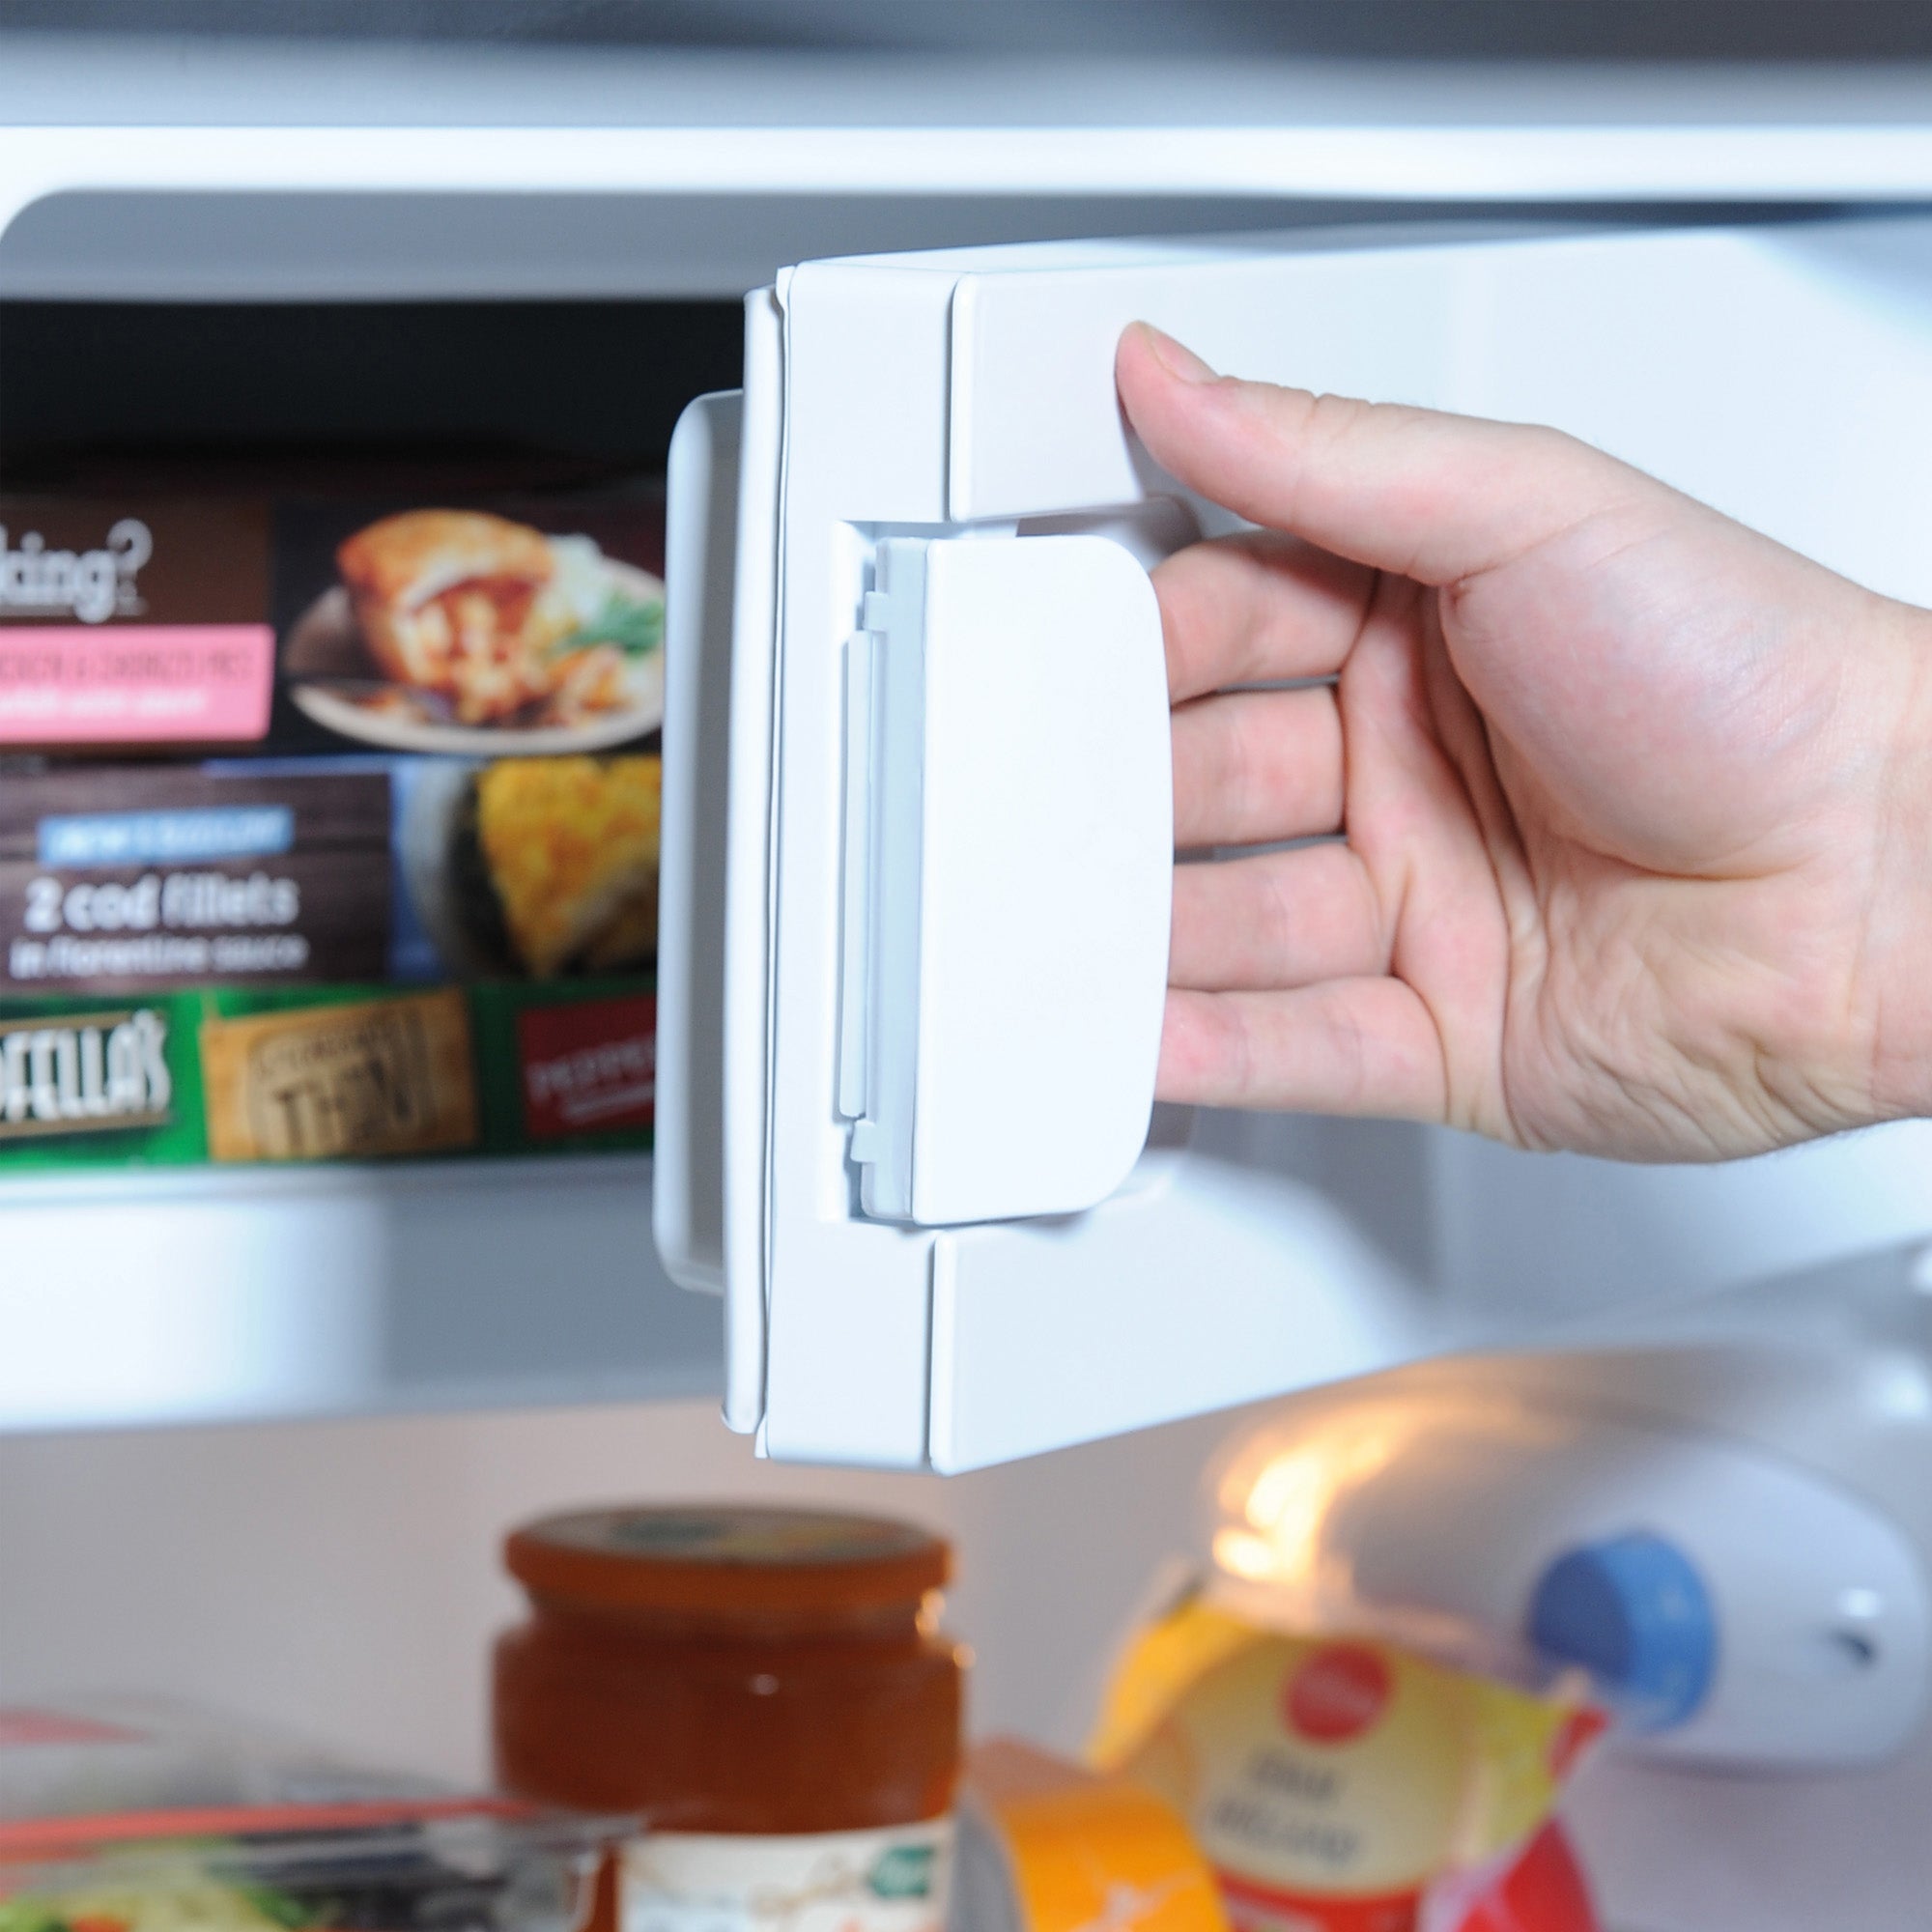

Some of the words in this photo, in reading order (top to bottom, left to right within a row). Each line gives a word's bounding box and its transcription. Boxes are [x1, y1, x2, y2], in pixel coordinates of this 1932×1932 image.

[24, 877, 64, 932] 2
[64, 873, 160, 931] cod
[162, 871, 300, 928] fillets
[9, 937, 46, 979] in
[211, 933, 310, 971] sauce
